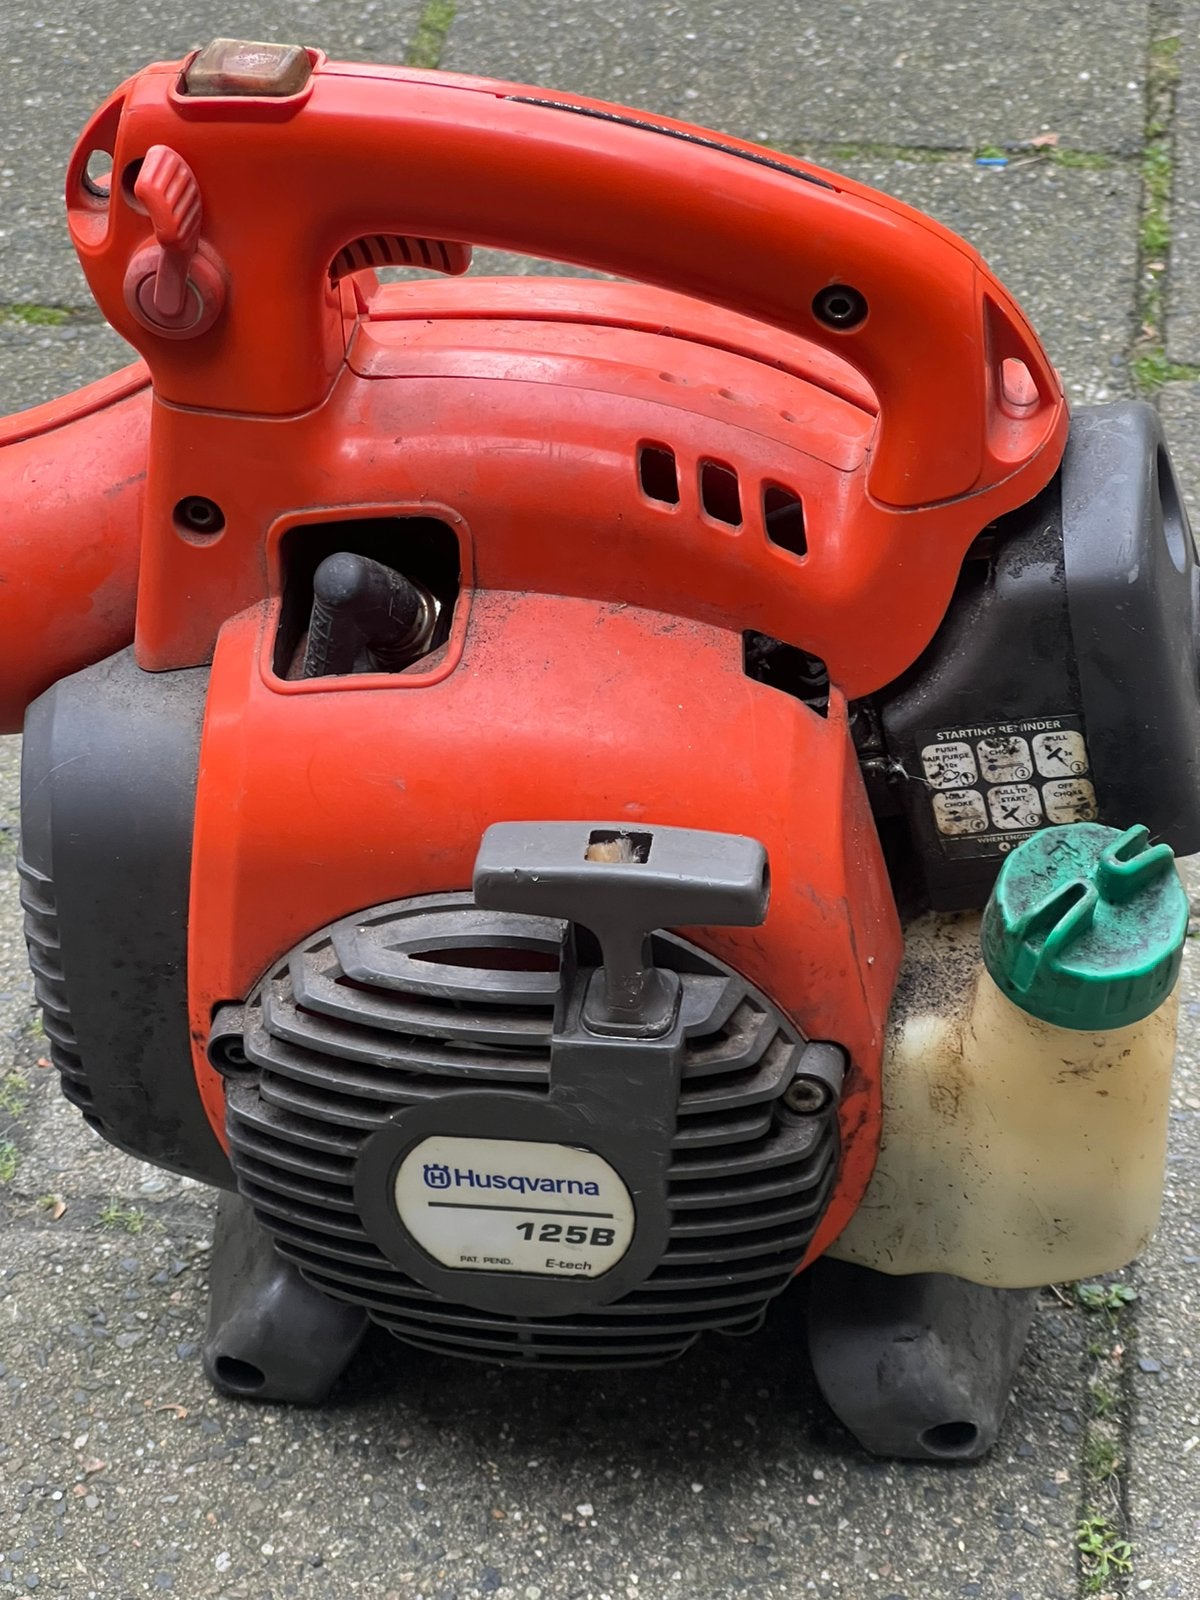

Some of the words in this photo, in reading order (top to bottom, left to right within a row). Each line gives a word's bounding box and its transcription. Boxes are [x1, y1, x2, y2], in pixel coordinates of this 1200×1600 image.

[937, 727, 996, 740] STARTING
[943, 752, 969, 761] PURGE
[1001, 795, 1027, 803] START
[977, 835, 1004, 843] WHEN
[455, 1169, 600, 1196] Husqvarna
[516, 1222, 616, 1247] 125B
[460, 1255, 480, 1264] PAT.
[483, 1256, 514, 1266] PEND.
[545, 1258, 592, 1271] E-tech
